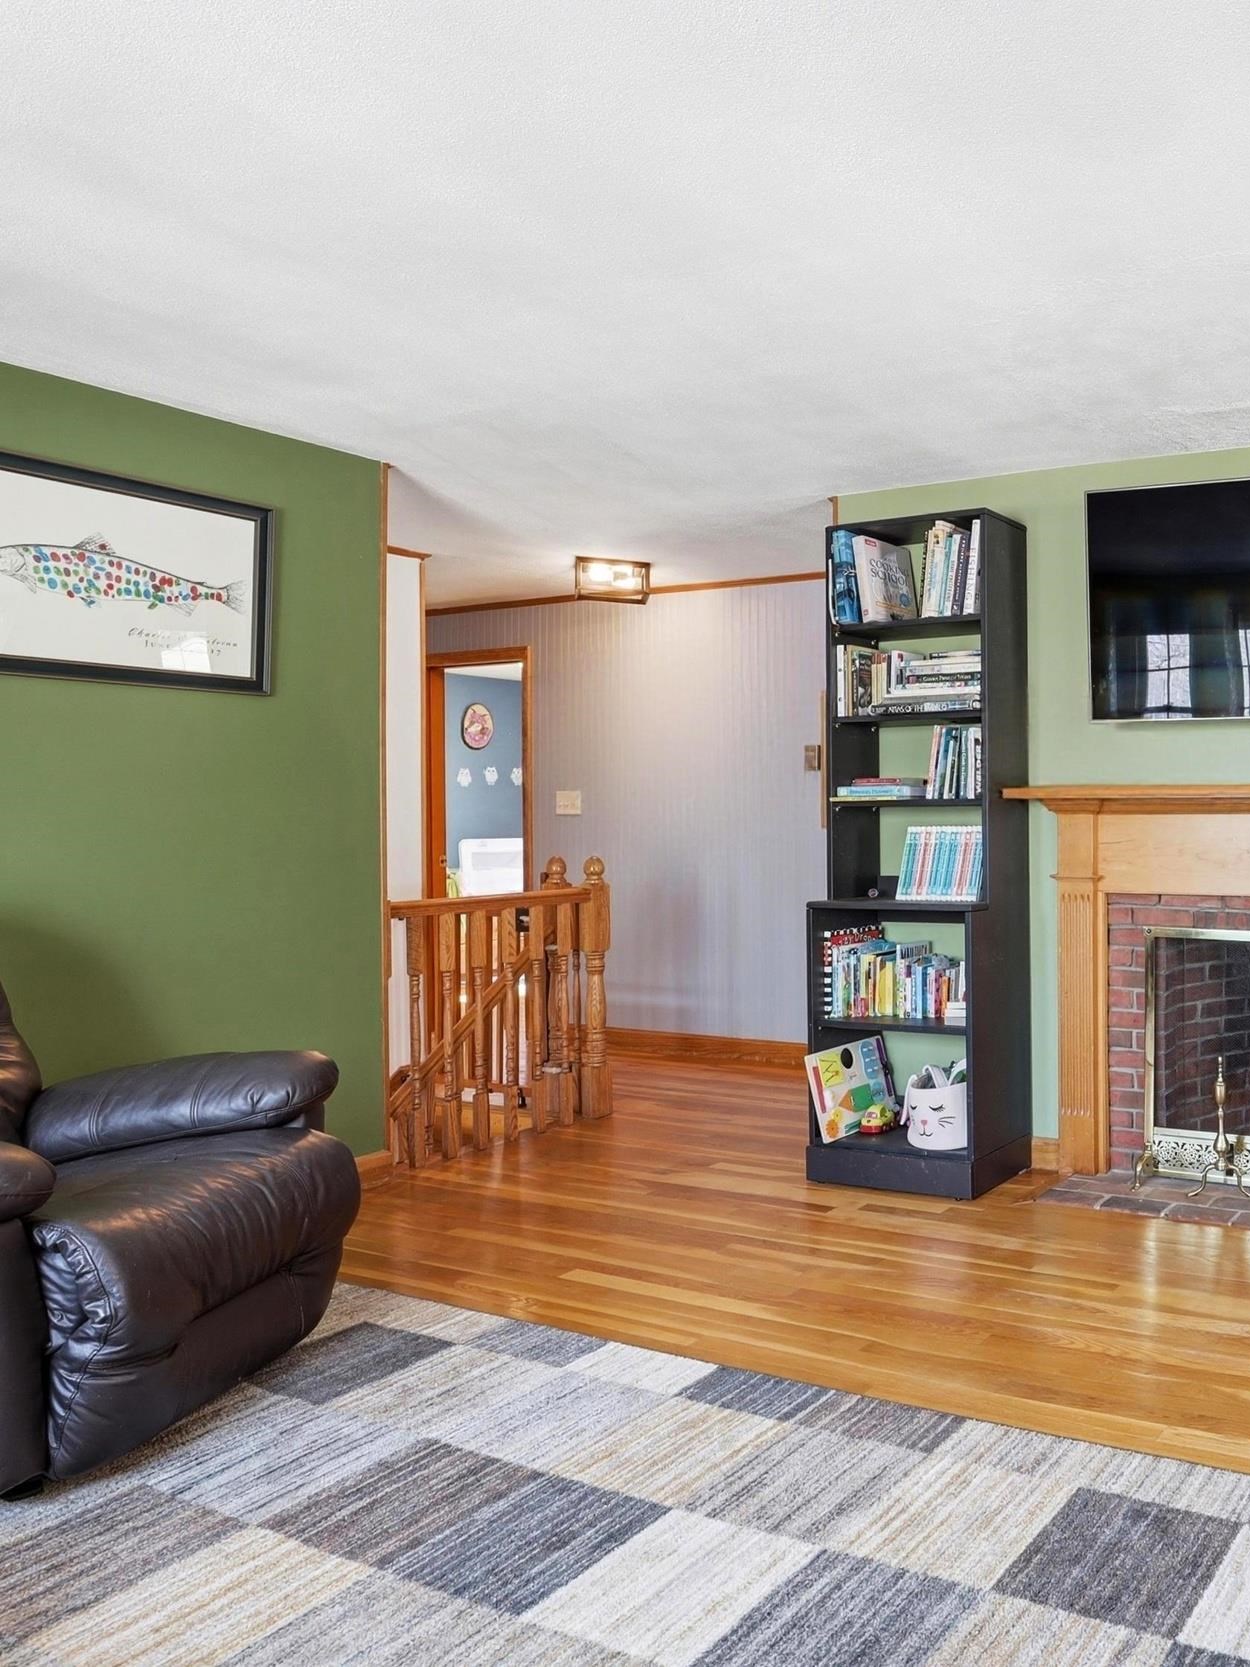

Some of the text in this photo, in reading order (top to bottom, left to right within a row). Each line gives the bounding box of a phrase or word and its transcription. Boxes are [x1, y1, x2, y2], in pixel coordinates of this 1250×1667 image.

[869, 558, 909, 577] COOKING
[965, 547, 976, 600] FISHING
[870, 568, 908, 586] SCHOOL
[887, 704, 904, 714] ATLAS
